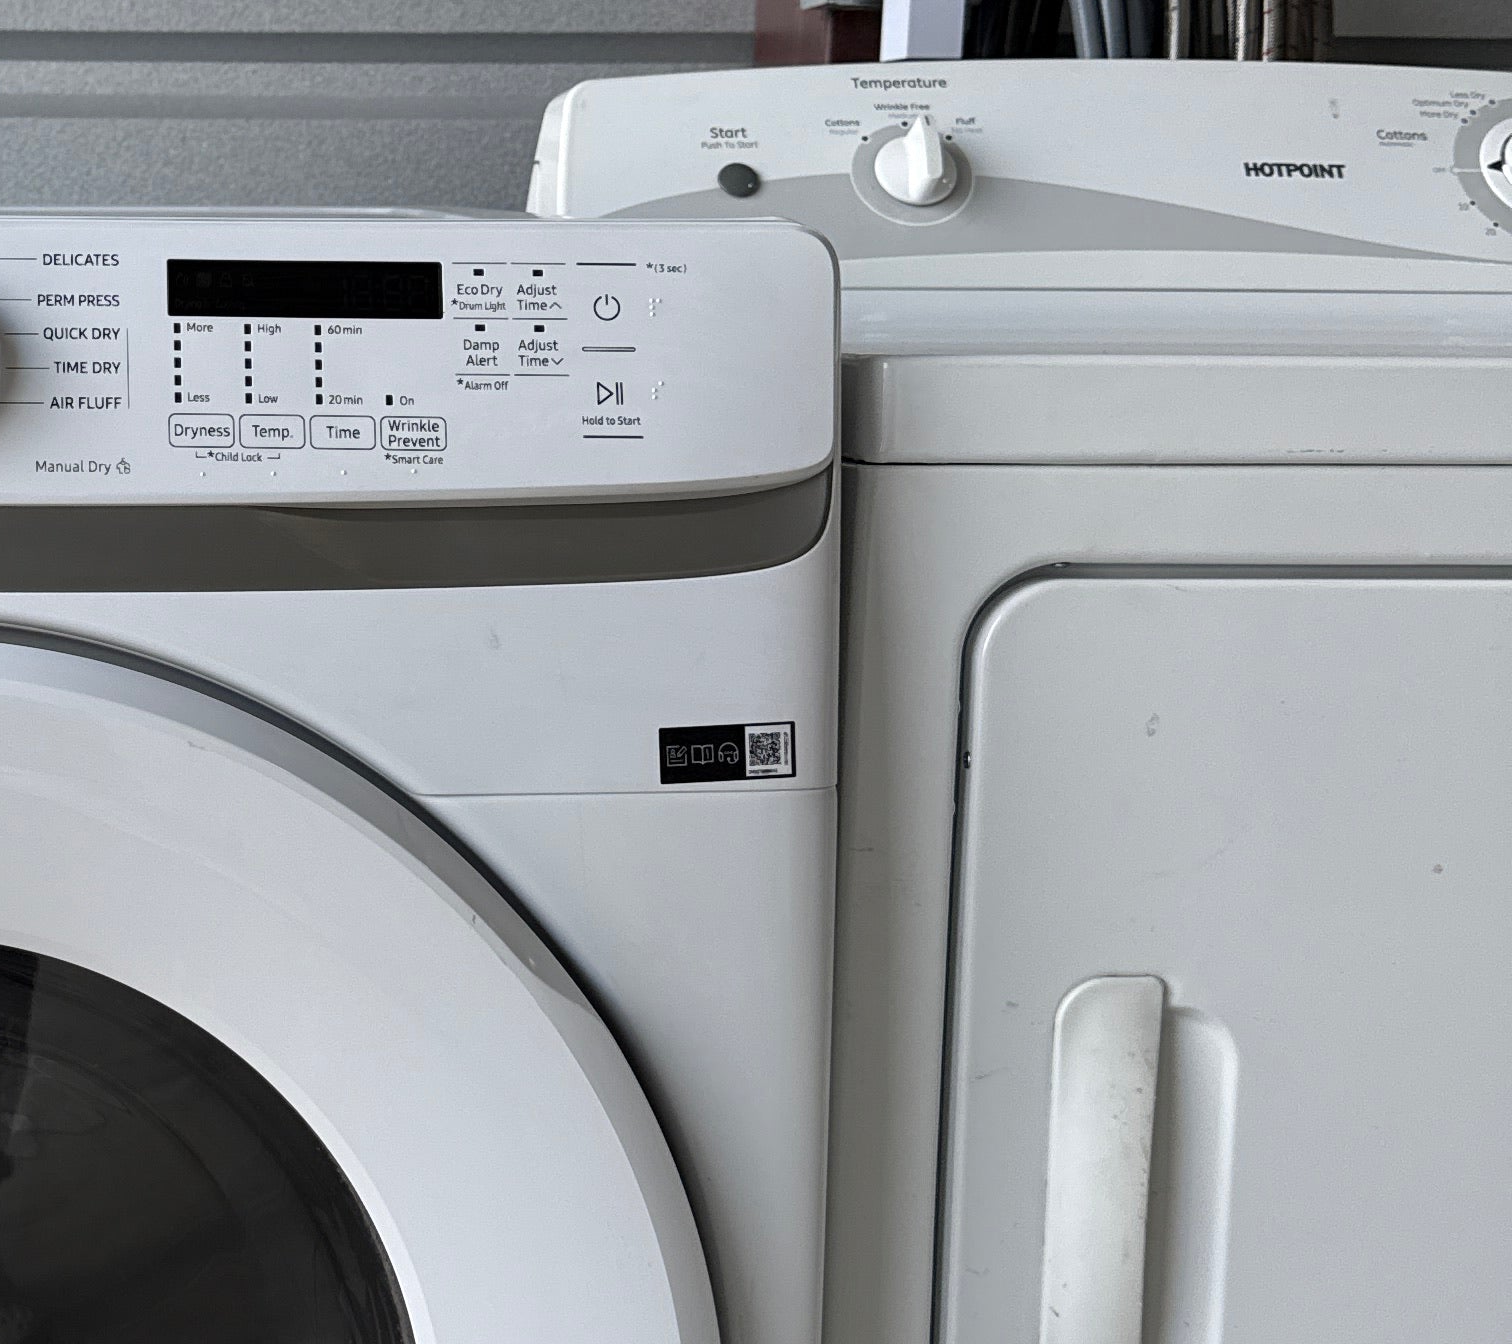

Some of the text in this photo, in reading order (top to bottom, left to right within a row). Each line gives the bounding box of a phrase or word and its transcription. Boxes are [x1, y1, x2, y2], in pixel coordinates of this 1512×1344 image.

[851, 77, 948, 91] Temperature
[709, 127, 748, 140] Start
[1376, 129, 1428, 142] Cottons
[1243, 161, 1347, 180] HOTPOINT
[42, 254, 120, 267] DELICATES
[517, 284, 558, 299] Adjust
[38, 294, 120, 307] PERM PRESS
[485, 301, 507, 313] Light
[518, 300, 548, 312] Time
[43, 327, 121, 340] QUICK DRY
[186, 323, 214, 333] More
[257, 324, 283, 336] High
[463, 340, 501, 353] Damp
[518, 340, 559, 354] Adjust
[54, 361, 122, 374] TIME DRY
[466, 356, 499, 367] Alert
[518, 356, 550, 367] Time
[494, 380, 510, 391] Off
[50, 397, 123, 410] AIR FLUFF
[187, 393, 211, 403] Less
[258, 393, 279, 404] Low
[399, 396, 416, 406] On
[388, 420, 441, 433] Wrinkle
[582, 416, 642, 427] Hold to Start
[174, 424, 231, 439] Dryness
[251, 424, 294, 441] Temp.
[326, 425, 361, 440] Time
[388, 435, 441, 448] Prevent
[241, 452, 264, 463] Lock
[422, 455, 445, 466] Care
[35, 460, 112, 476] Manual Dry
